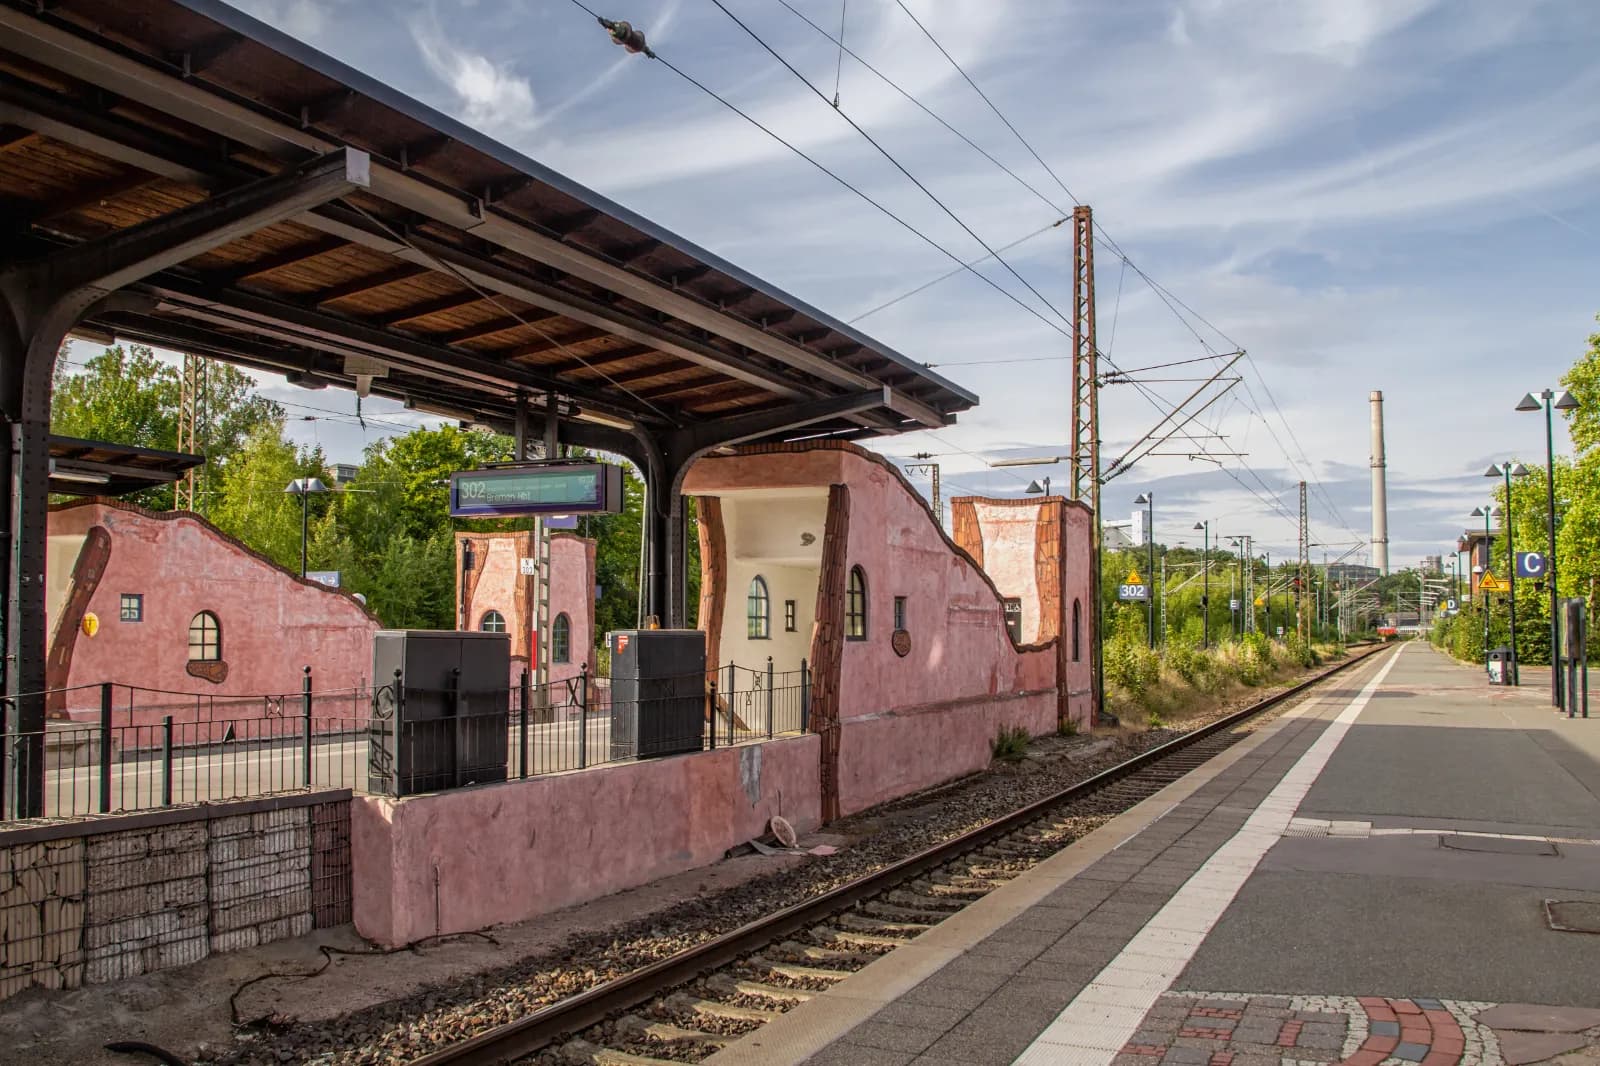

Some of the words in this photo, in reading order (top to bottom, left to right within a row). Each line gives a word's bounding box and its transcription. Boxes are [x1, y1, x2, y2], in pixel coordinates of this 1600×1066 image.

[461, 482, 485, 499] 302
[1524, 552, 1541, 573] C
[1121, 584, 1145, 597] 302
[1447, 599, 1456, 609] D
